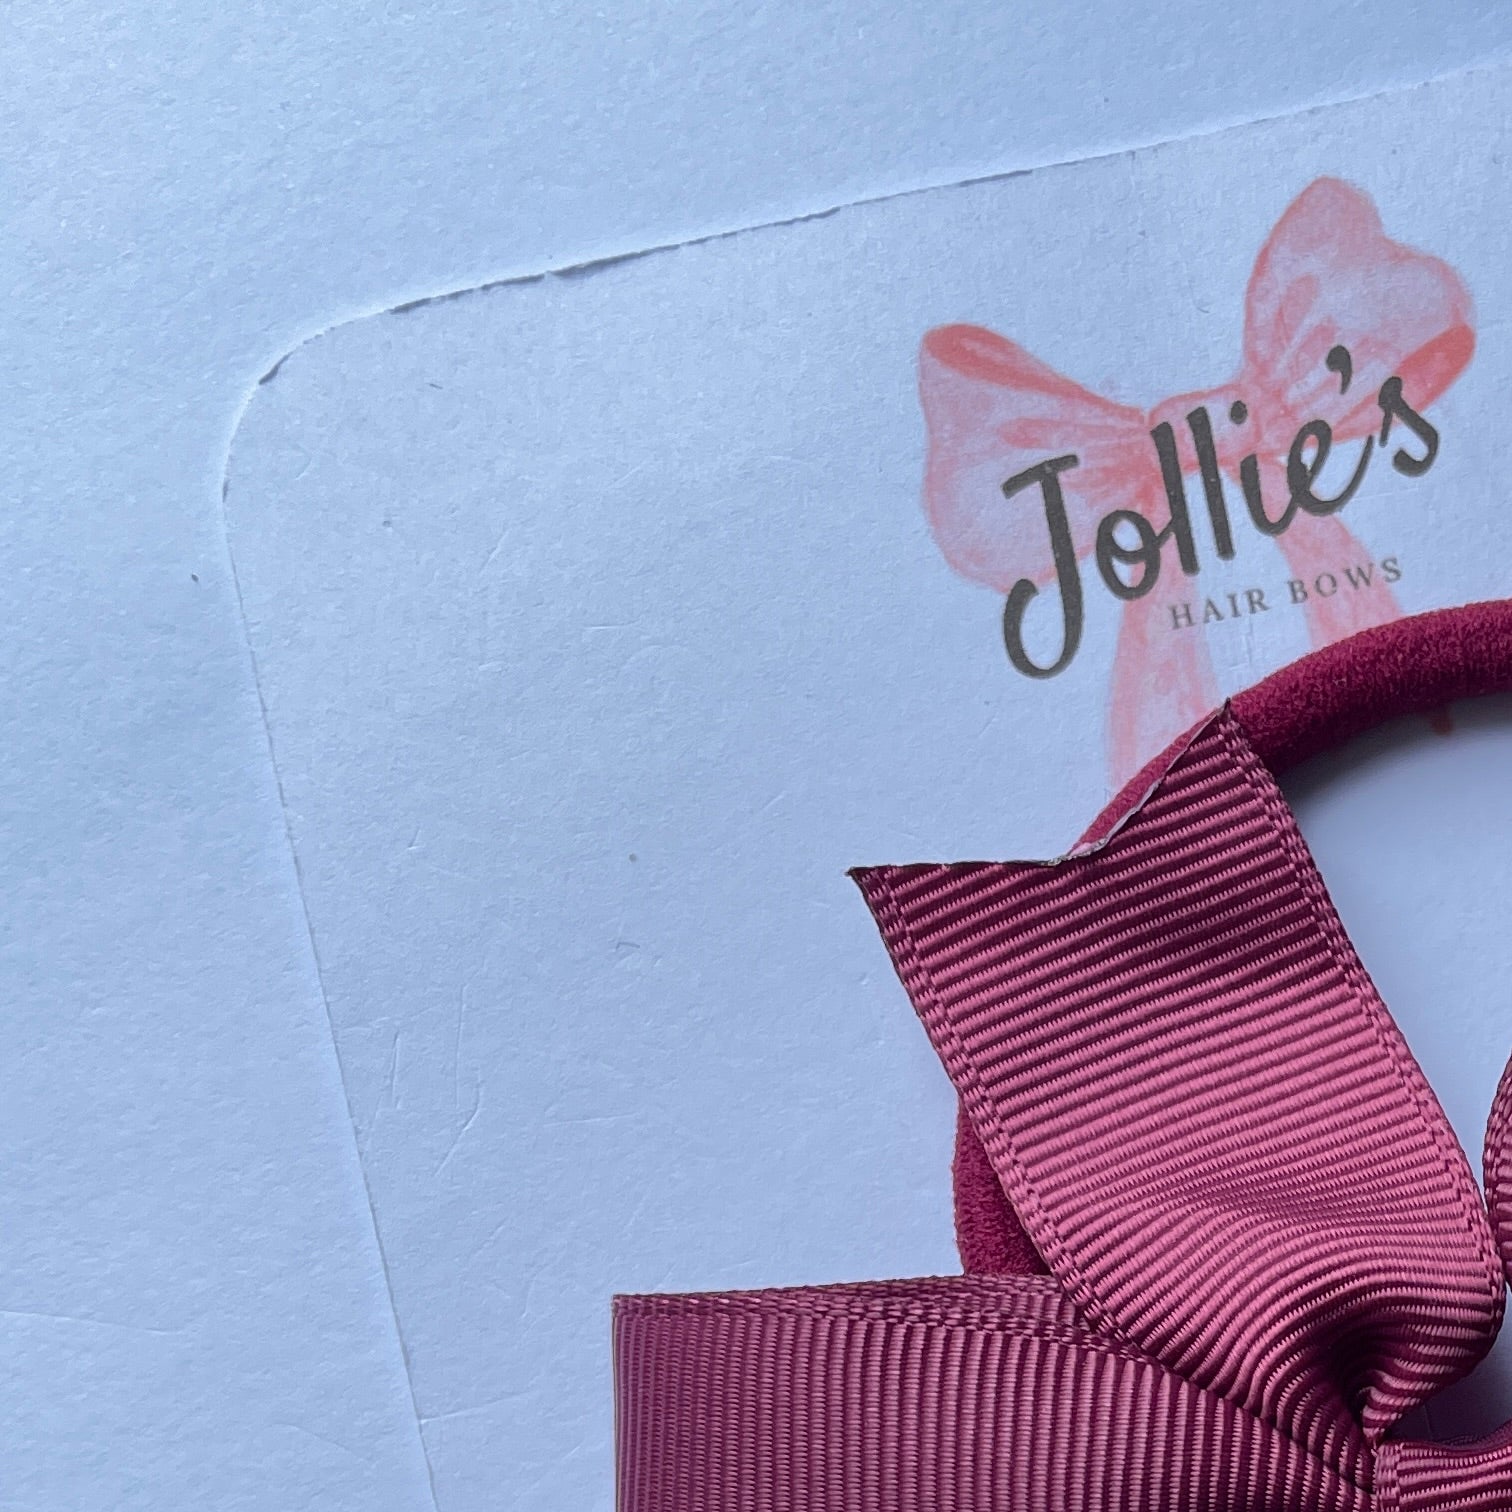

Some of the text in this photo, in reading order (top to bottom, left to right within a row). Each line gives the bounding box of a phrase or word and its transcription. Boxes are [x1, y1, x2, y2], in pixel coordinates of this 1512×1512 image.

[1002, 345, 1440, 679] Jollie's
[1168, 557, 1404, 630] HAIR BOWS
